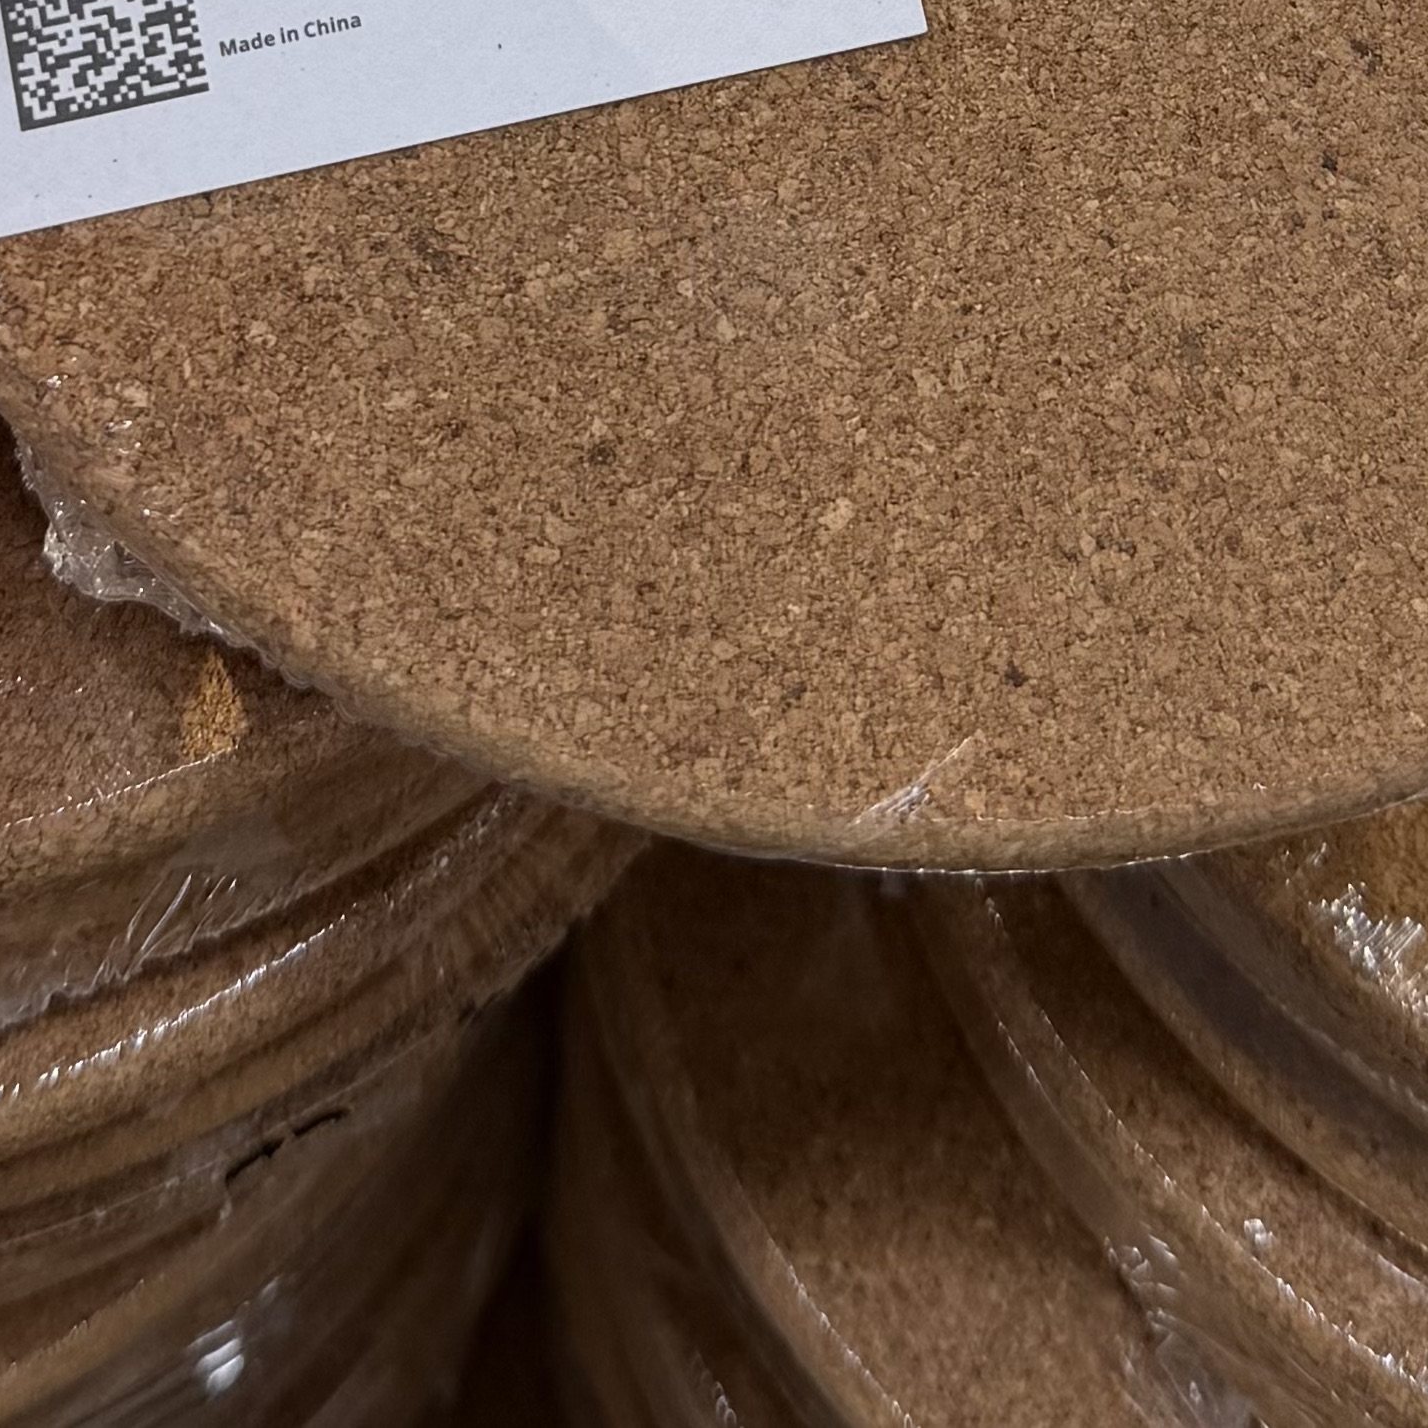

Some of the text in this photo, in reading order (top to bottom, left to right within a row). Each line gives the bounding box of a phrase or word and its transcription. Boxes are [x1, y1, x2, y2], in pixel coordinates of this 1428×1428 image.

[218, 14, 361, 57] Made in China
